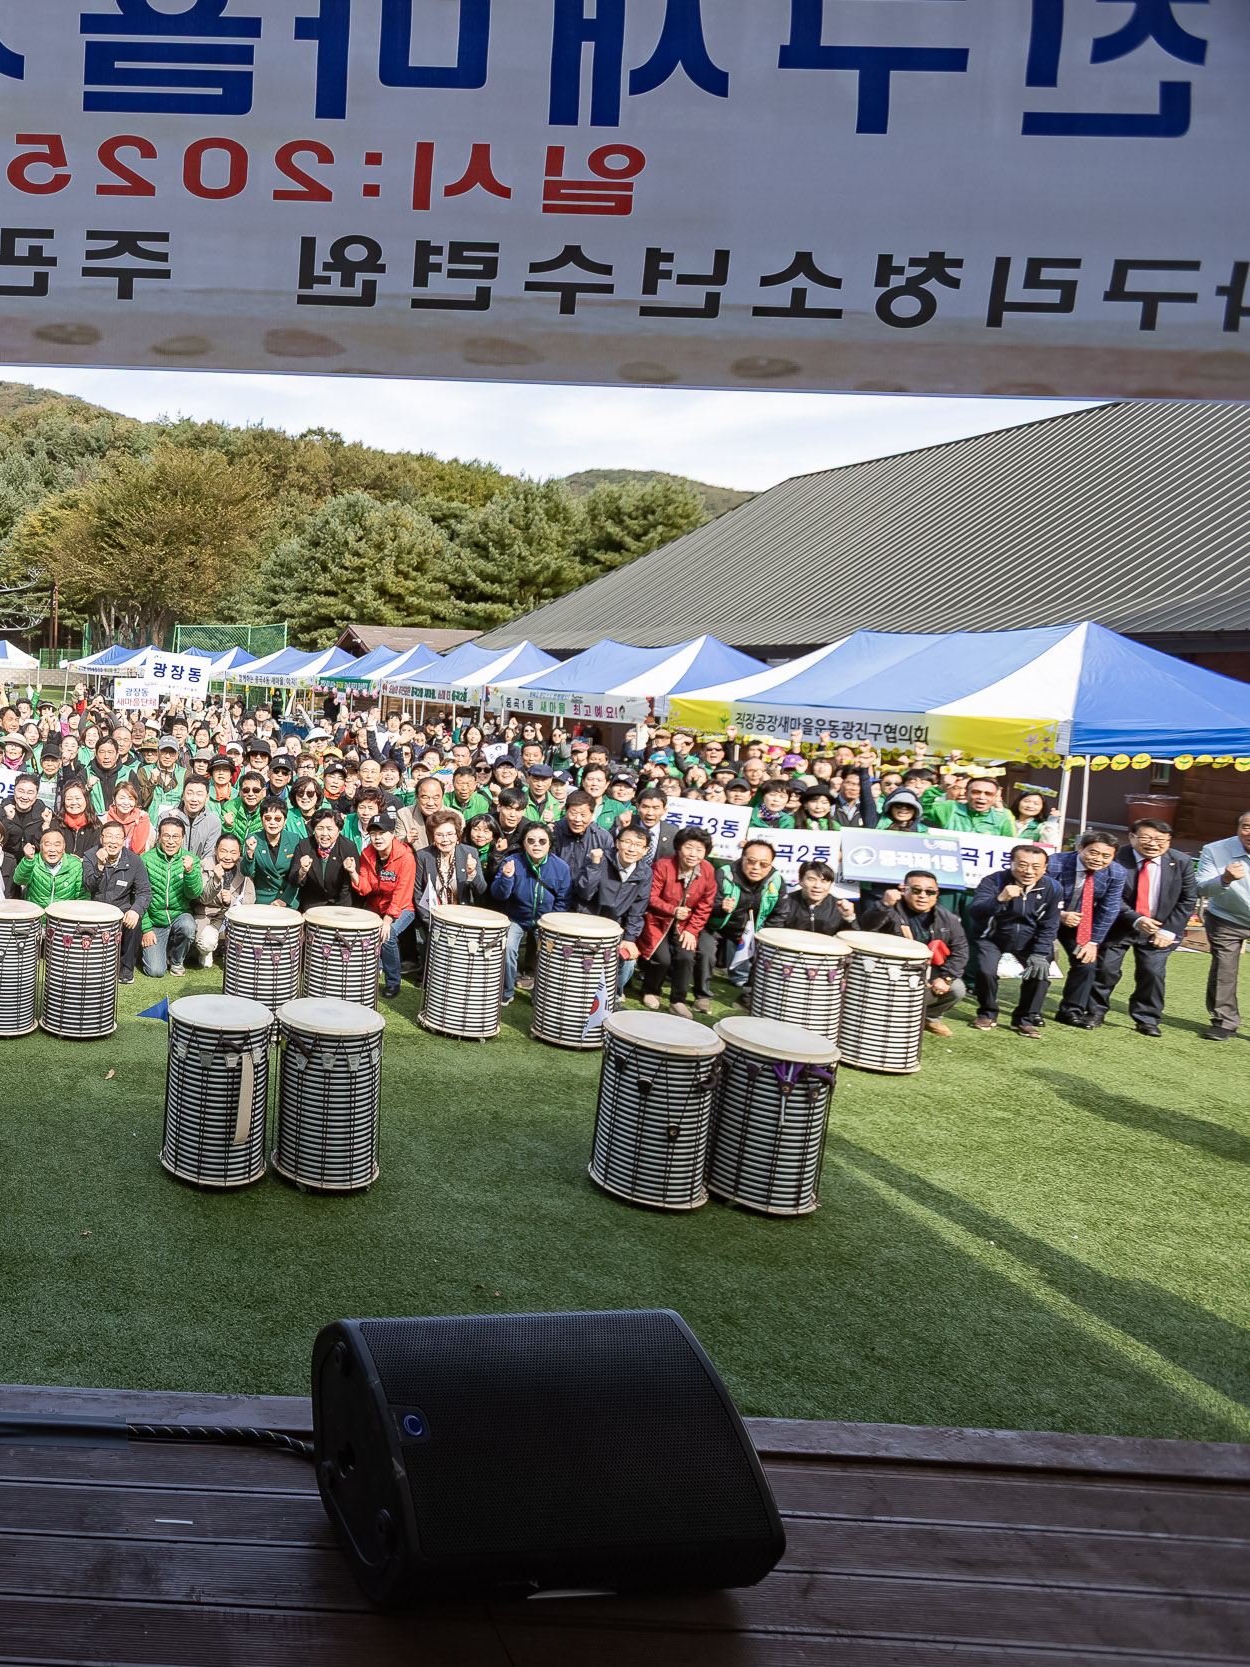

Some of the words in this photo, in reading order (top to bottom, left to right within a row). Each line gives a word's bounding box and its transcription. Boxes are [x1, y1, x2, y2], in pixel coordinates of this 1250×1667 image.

[153, 662, 202, 683] 광장동
[125, 687, 149, 697] 광장동
[116, 698, 157, 707] 새마을단체
[506, 697, 534, 710] 중곡1동
[539, 701, 566, 715] 새마을
[775, 844, 831, 863] 곡2동
[961, 847, 1011, 871] 곡1동
